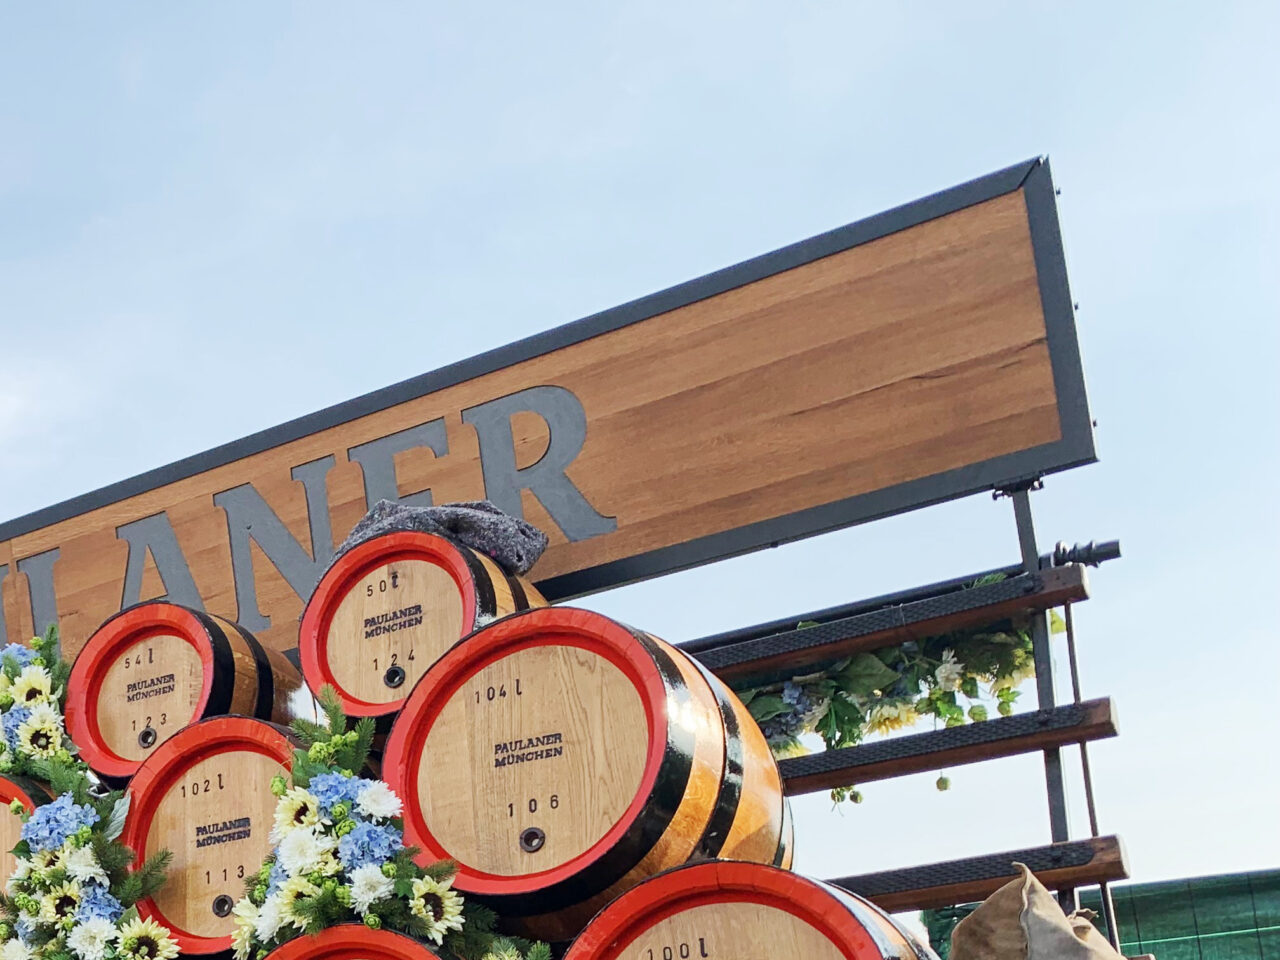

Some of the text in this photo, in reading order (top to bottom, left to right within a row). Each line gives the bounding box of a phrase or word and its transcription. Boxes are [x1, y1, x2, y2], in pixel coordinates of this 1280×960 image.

[363, 604, 423, 629] PAULANER
[364, 616, 424, 640] MÜNCHEN
[126, 673, 176, 693] PAULANER
[126, 684, 176, 703] MÜNCHEN
[494, 732, 563, 755] PAULANER
[494, 746, 564, 768] MÜNCHEN
[195, 817, 251, 837] PAULANER
[196, 829, 252, 848] MÜNCHEN
